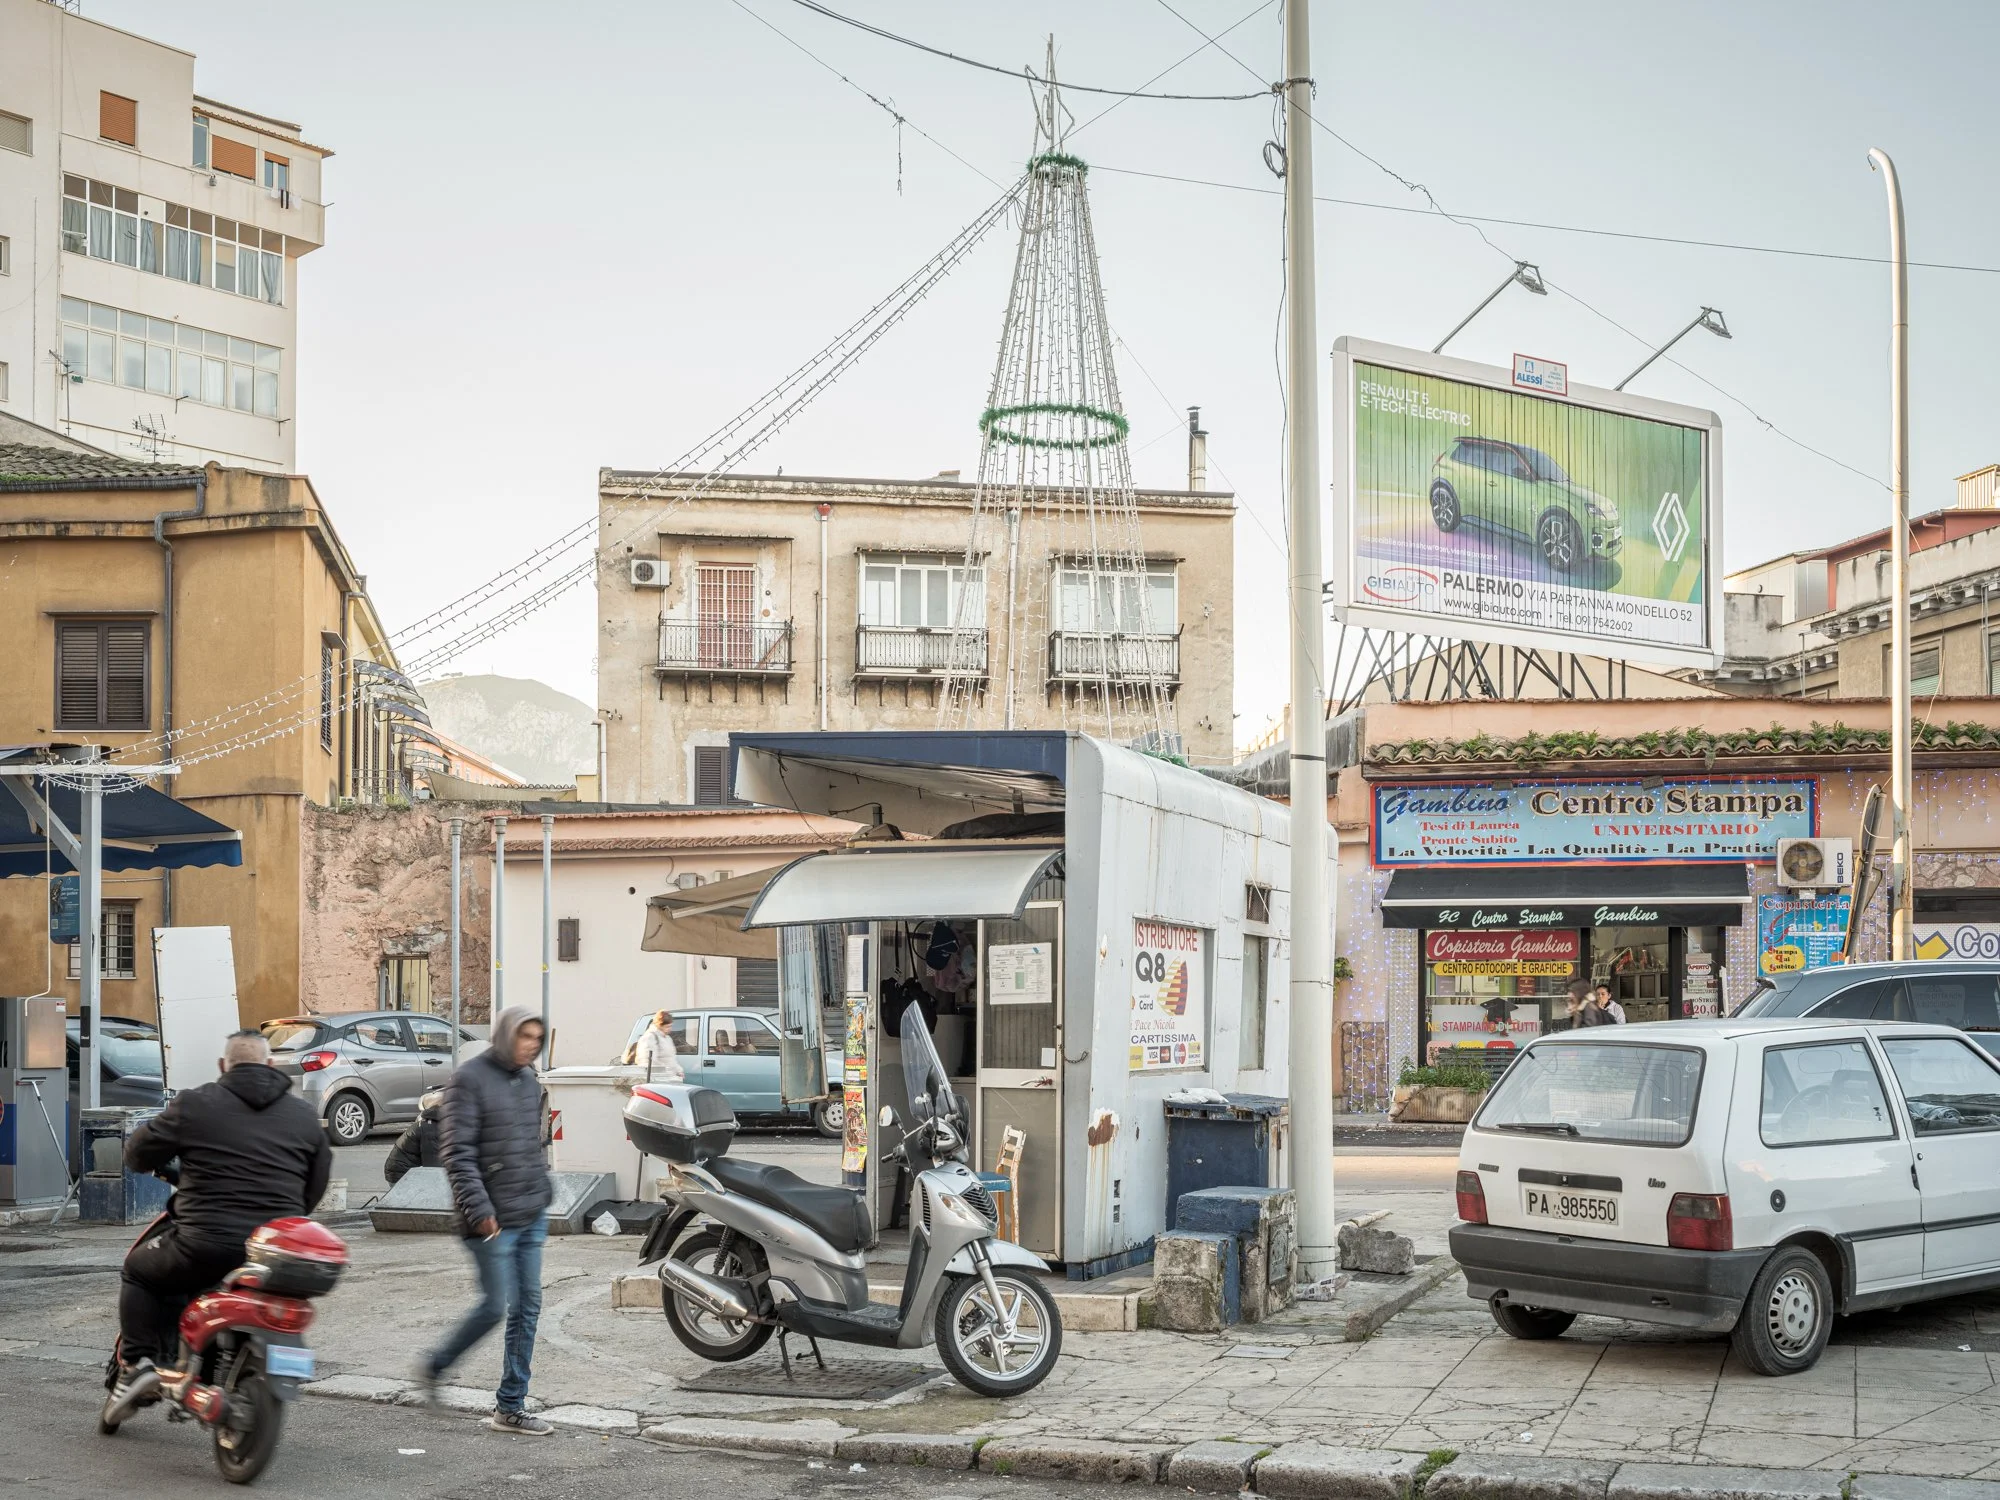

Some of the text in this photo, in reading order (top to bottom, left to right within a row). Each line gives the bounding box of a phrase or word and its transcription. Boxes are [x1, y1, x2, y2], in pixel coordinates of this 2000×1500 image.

[1361, 380, 1430, 405] RENAULT 5
[1361, 394, 1471, 426] E-TECH ELECTRIC
[1367, 575, 1435, 596] GIBIAUTO
[1443, 572, 1693, 622] PALERMO VIA PARTANNA MONDELLO 52
[1444, 598, 1542, 620] www.gibiauto.com
[1593, 616, 1633, 632] 7542602
[1383, 788, 1805, 824] Gambino Centro Stampa
[1421, 820, 1521, 831] Tesi di Laurea
[1594, 824, 1759, 836] UNIVERSITARIO
[1389, 847, 1416, 857] La
[1423, 844, 1508, 857] Velocità
[1527, 845, 1556, 855] La
[1563, 843, 1648, 856] Qualità
[1667, 843, 1696, 854] La
[1705, 842, 1775, 854] Pratic
[1421, 834, 1518, 845] Pronte Subito
[1836, 852, 1844, 884] BEKO
[1763, 898, 1850, 911] Copisteria
[1472, 909, 1509, 928] Centro
[1519, 908, 1564, 925] Stampa
[1594, 906, 1659, 925] Gambino
[1434, 934, 1574, 958] Copisteria Gambino
[1954, 925, 2000, 959] Co
[1135, 951, 1166, 983] Q8
[1443, 962, 1567, 974] CENTRO FOTOCOPIE E GRAFICHE
[1139, 1000, 1153, 1010] Card
[1442, 1021, 1496, 1032] STAMPIAMO
[1511, 1021, 1538, 1032] TUTTI
[1131, 1034, 1197, 1044] CARTISSIMA
[1149, 1051, 1158, 1059] VISA
[1648, 1178, 1666, 1188] Uno
[1528, 1192, 1549, 1214] PA
[1561, 1196, 1616, 1221] 985550
